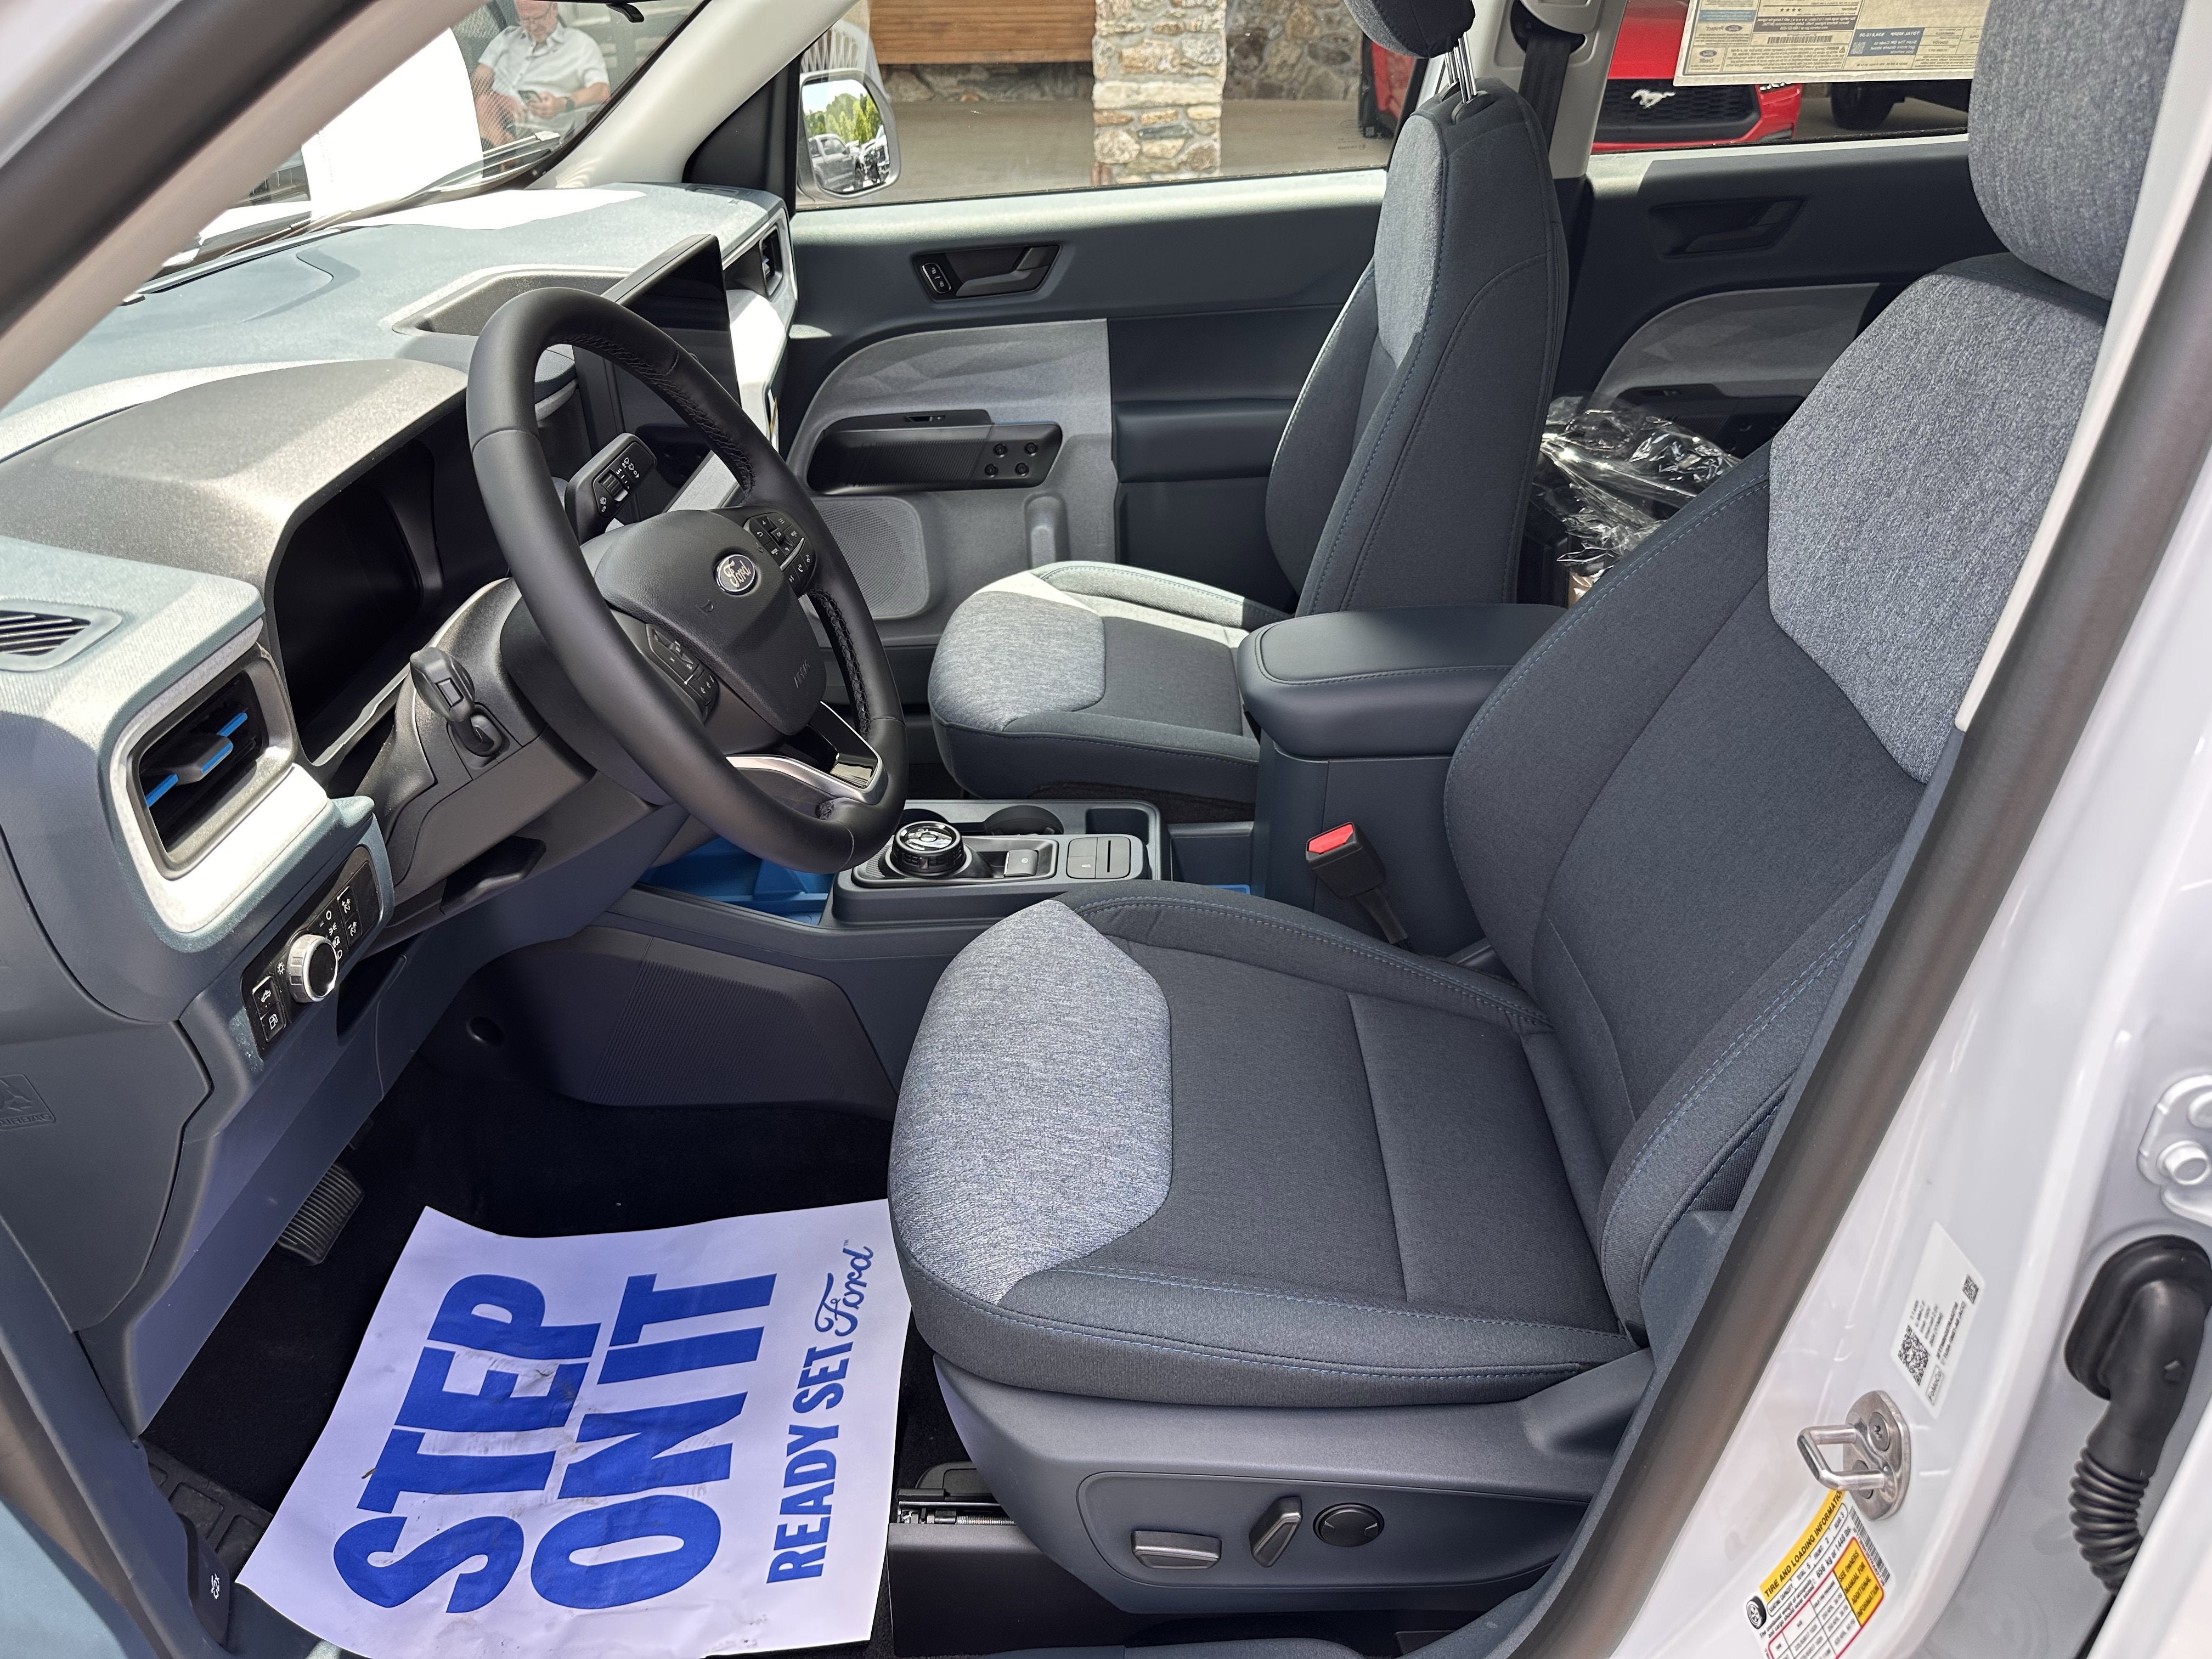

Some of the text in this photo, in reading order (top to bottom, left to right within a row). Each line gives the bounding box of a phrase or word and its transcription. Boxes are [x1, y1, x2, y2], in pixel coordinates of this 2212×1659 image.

[723, 560, 752, 588] Ford
[792, 1341, 854, 1414] SET
[1928, 1370, 1942, 1402] FoMoCo
[334, 1273, 602, 1613] STEP
[531, 1273, 777, 1610] ON IT
[767, 1425, 839, 1584] READY
[1764, 1490, 1841, 1597] TIRE AND LOADING INFORMATIO
[1825, 1556, 1833, 1566] kg
[1831, 1549, 1836, 1559] or
[1835, 1534, 1846, 1550] 1448
[1838, 1550, 1859, 1582] SEE OWNERS
[1844, 1561, 1865, 1594] MANUAL FOR
[1767, 1613, 1782, 1632] combined
[1782, 1601, 1793, 1615] weight
[1796, 1579, 1812, 1599] occupants
[1775, 1620, 1784, 1631] cargo
[1784, 1607, 1795, 1621] should
[1794, 1598, 1803, 1609] never
[1803, 1583, 1814, 1599] exceed
[1852, 1576, 1871, 1605] ADDITIONAL
[1857, 1584, 1879, 1617] INFORMATION
